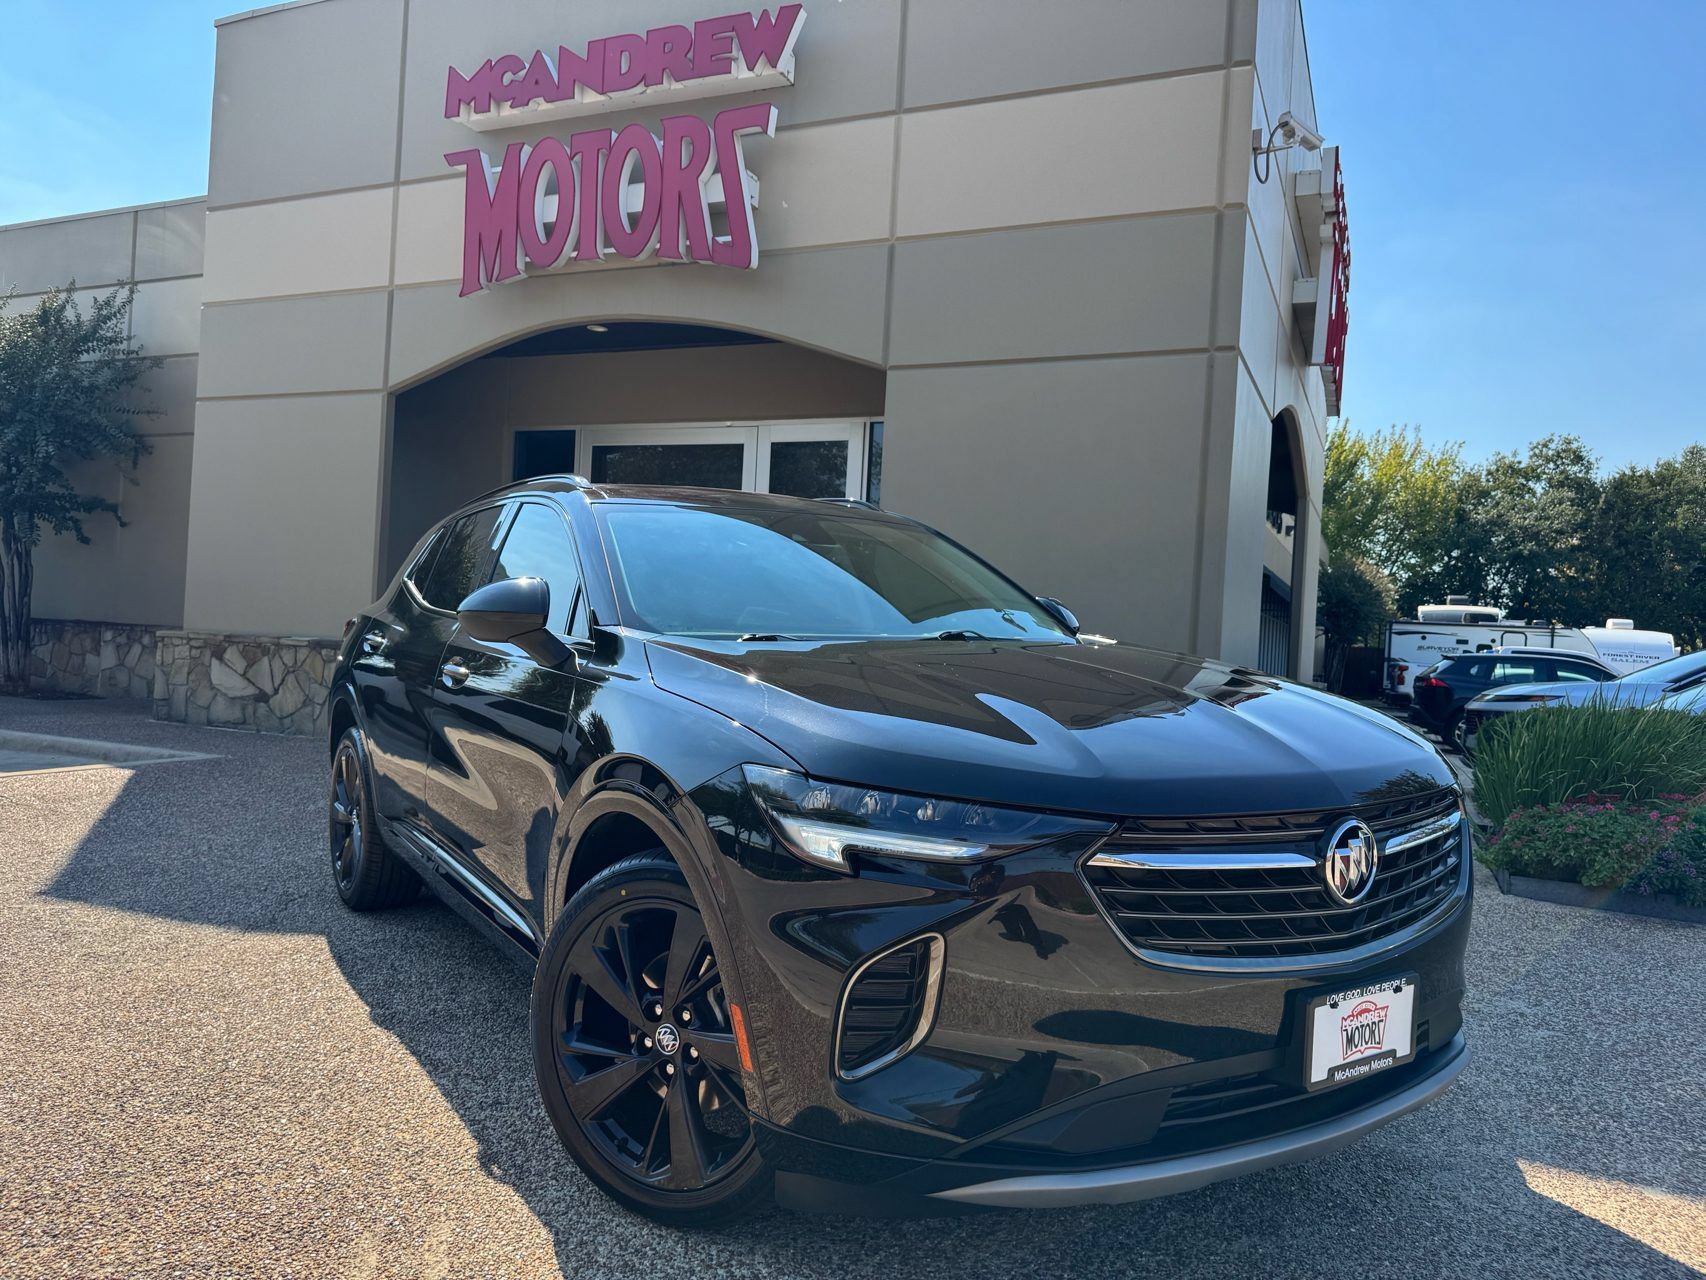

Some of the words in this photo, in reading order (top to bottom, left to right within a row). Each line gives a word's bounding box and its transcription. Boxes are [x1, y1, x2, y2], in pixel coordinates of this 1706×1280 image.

[444, 103, 775, 297] MOTORS
[1326, 993, 1344, 1005] LOVE
[1363, 984, 1380, 996] LOVE
[1343, 1019, 1384, 1055] MOTORS
[1334, 1064, 1369, 1081] McAndrew
[1370, 1056, 1393, 1070] Motors
